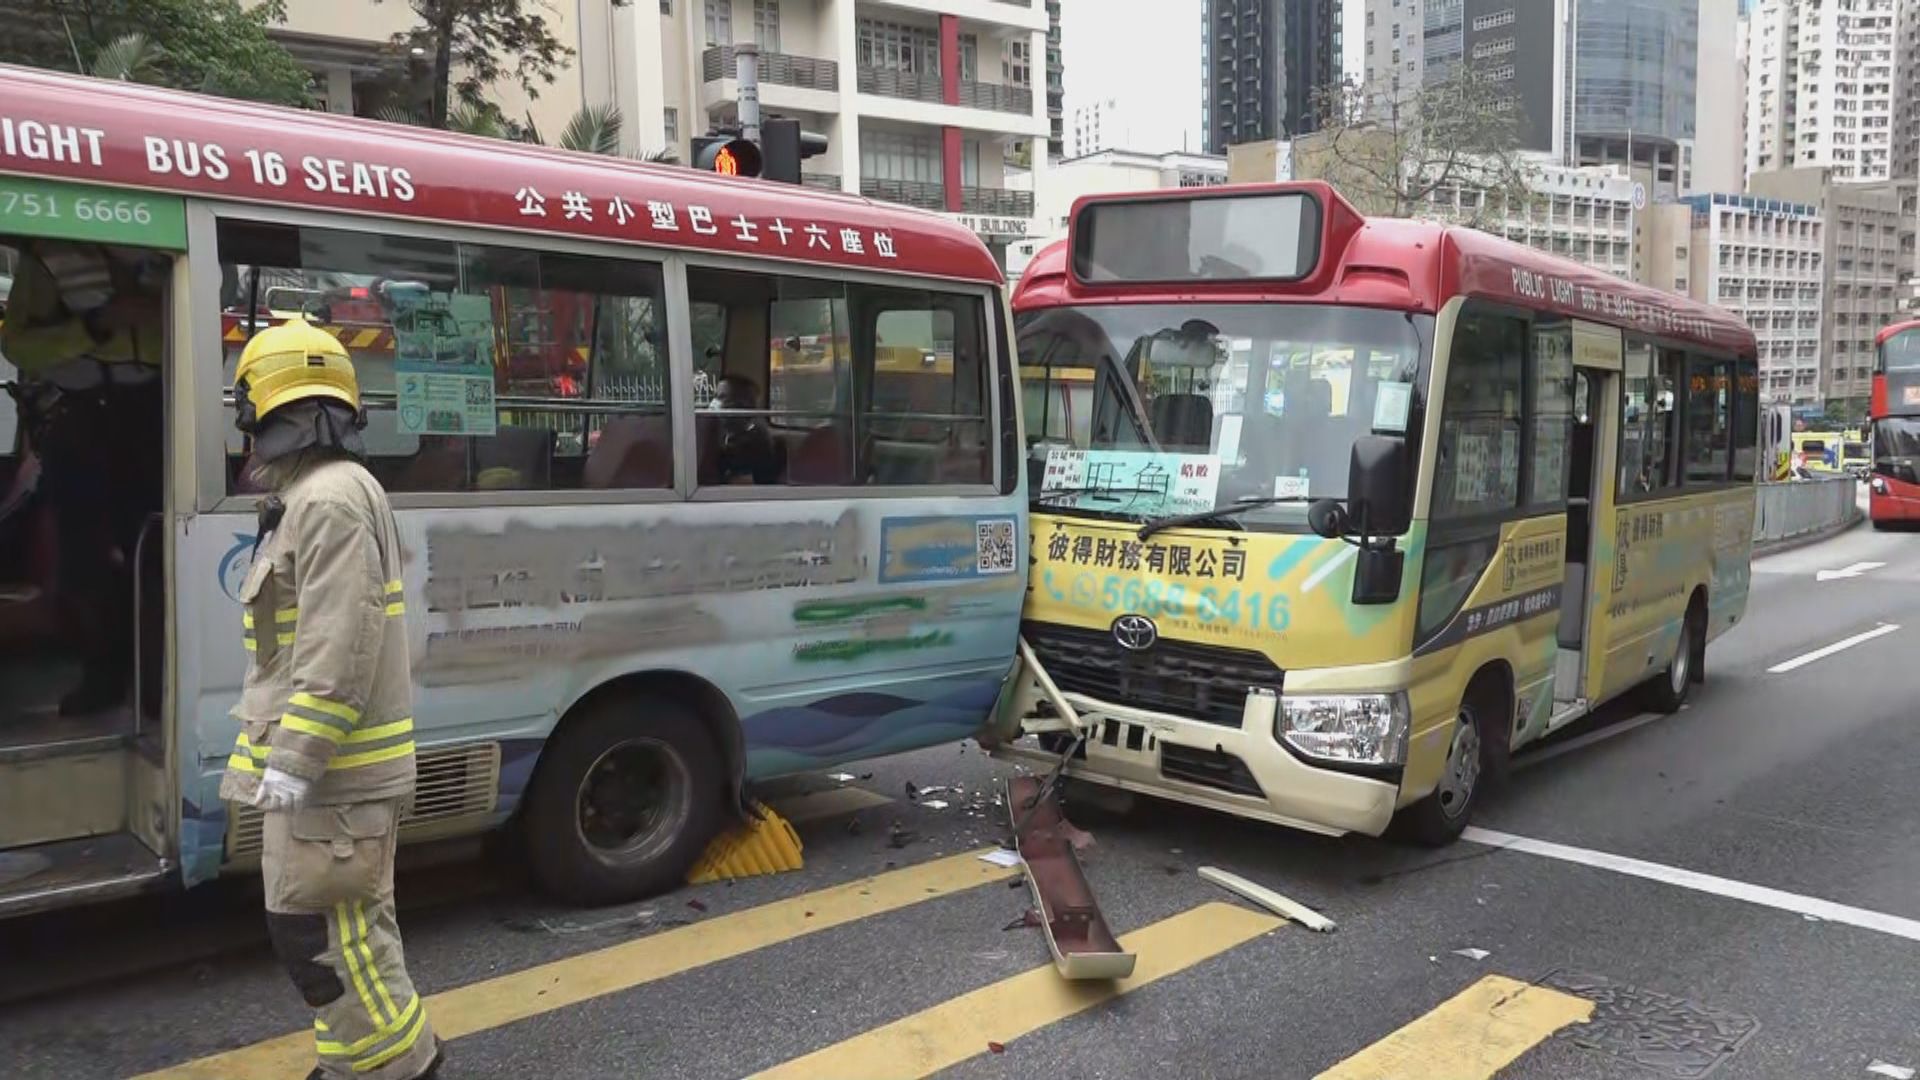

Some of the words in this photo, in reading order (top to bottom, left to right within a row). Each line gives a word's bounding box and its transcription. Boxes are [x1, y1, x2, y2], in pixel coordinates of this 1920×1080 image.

[0, 118, 105, 166] IGHT
[144, 136, 229, 180] BUS
[244, 150, 287, 185] 16
[302, 156, 415, 201] SEATS
[75, 198, 151, 225] 6666
[514, 186, 898, 258] 公共小型巴士十六座位
[980, 218, 1027, 233] BUILDING
[1511, 268, 1545, 299] PUBLIC
[1550, 278, 1575, 303] LIGHT
[1581, 286, 1597, 312] BUS
[1048, 532, 1247, 581] 彼得財務有限公司
[1199, 583, 1291, 631] 6416
